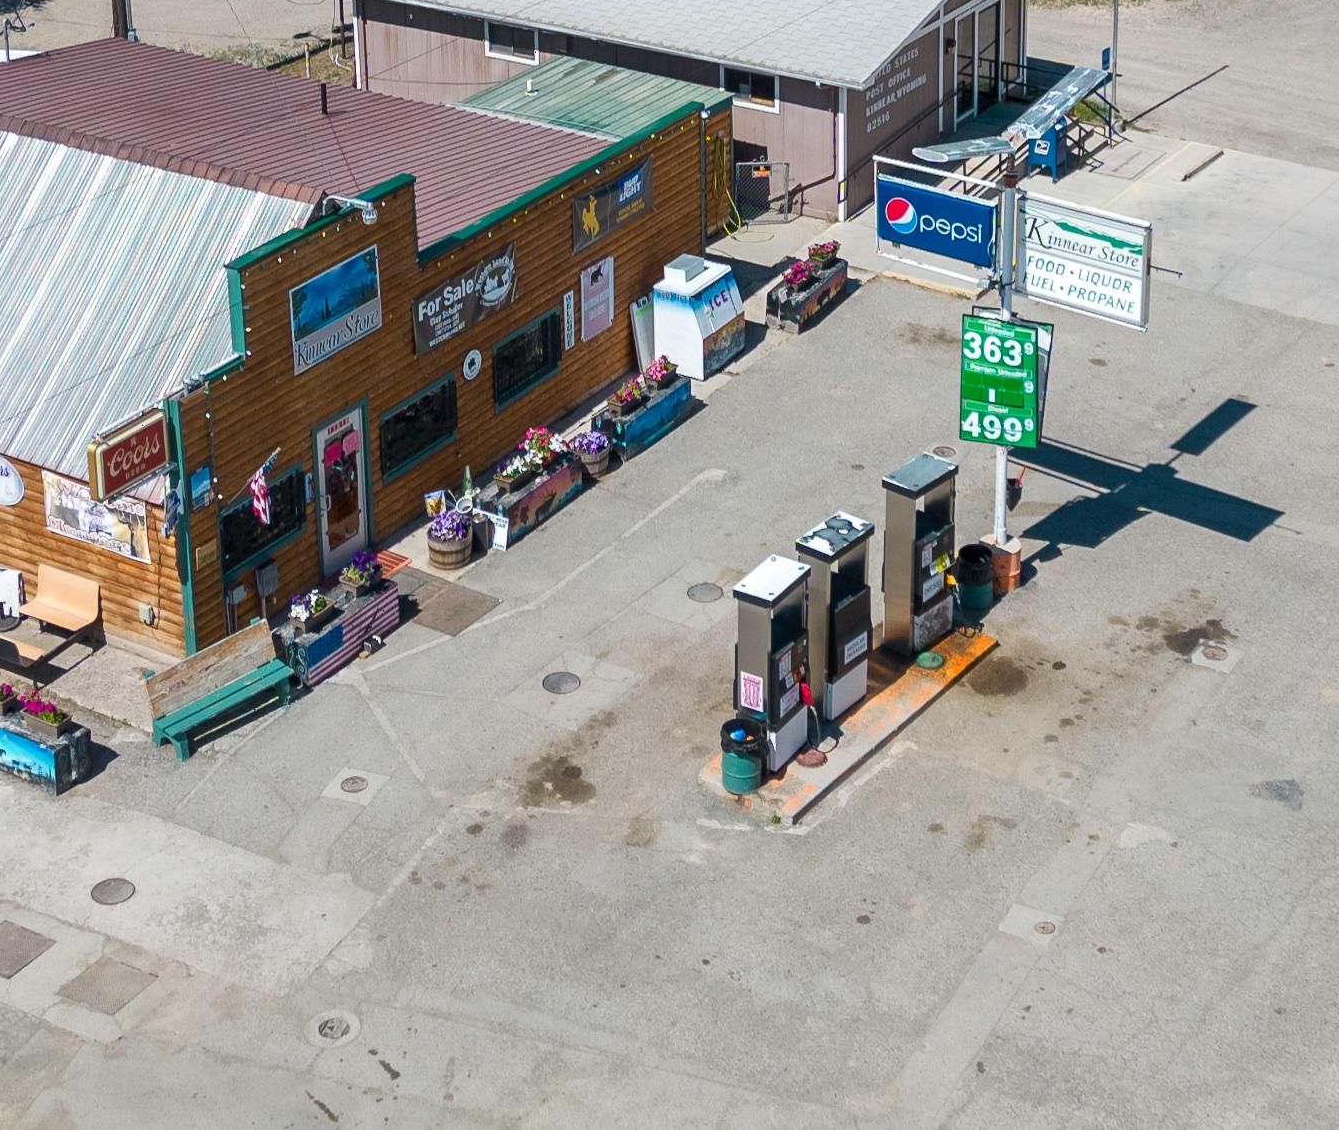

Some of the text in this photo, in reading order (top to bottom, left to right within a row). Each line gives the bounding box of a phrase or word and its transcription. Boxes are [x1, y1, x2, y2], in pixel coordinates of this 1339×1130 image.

[894, 47, 919, 69] STATES
[866, 67, 911, 101] POST OFFICE
[619, 181, 641, 202] LIGHT
[624, 173, 639, 189] BUD
[920, 214, 982, 244] pepsi
[1024, 217, 1140, 268] Kinnear Store
[1027, 255, 1133, 294] FOOD LIQUOR
[418, 296, 442, 322] For
[443, 278, 474, 306] Sale
[708, 289, 730, 311] ICE
[1022, 272, 1136, 314] FUEL PROPANE
[296, 309, 380, 368] Kinnear Store
[963, 331, 1022, 367] 363
[961, 411, 1023, 442] 499
[110, 432, 161, 478] Coors
